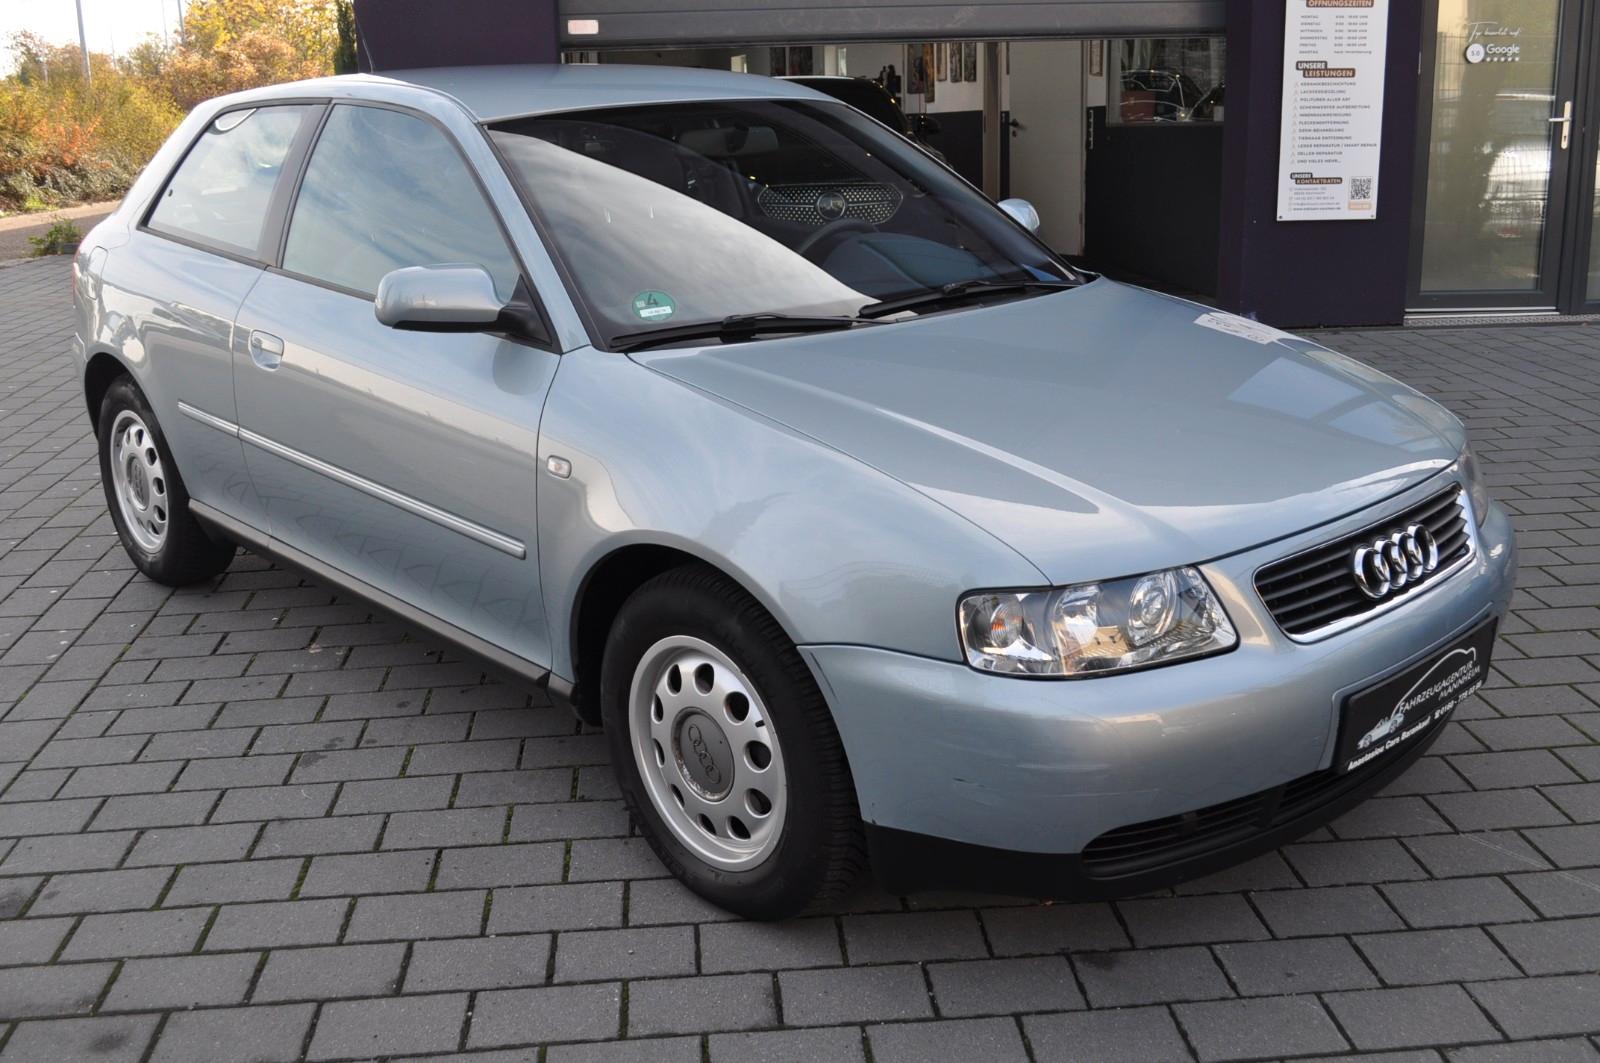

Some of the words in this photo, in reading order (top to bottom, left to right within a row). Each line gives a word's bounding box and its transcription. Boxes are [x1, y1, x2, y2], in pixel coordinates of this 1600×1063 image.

[1486, 44, 1520, 56] Google
[1398, 660, 1474, 712] FAHRZEUGAGENTUR
[1438, 665, 1480, 700] MANNHEIM
